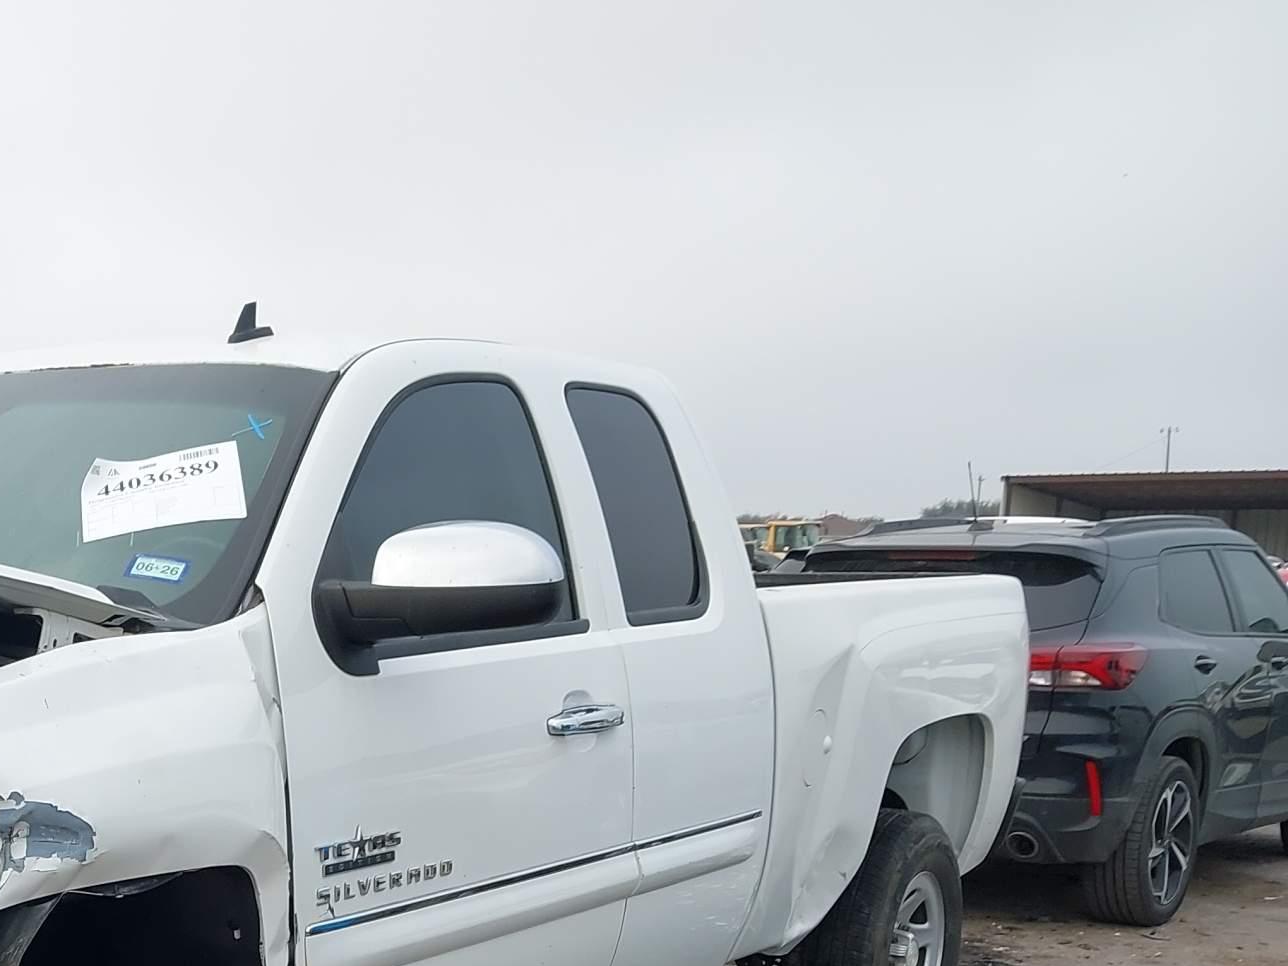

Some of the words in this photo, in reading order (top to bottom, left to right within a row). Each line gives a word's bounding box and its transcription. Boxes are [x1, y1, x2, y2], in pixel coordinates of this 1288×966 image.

[97, 459, 219, 497] 44036389
[314, 828, 402, 862] TEXAS
[316, 858, 453, 907] SILVERADO
